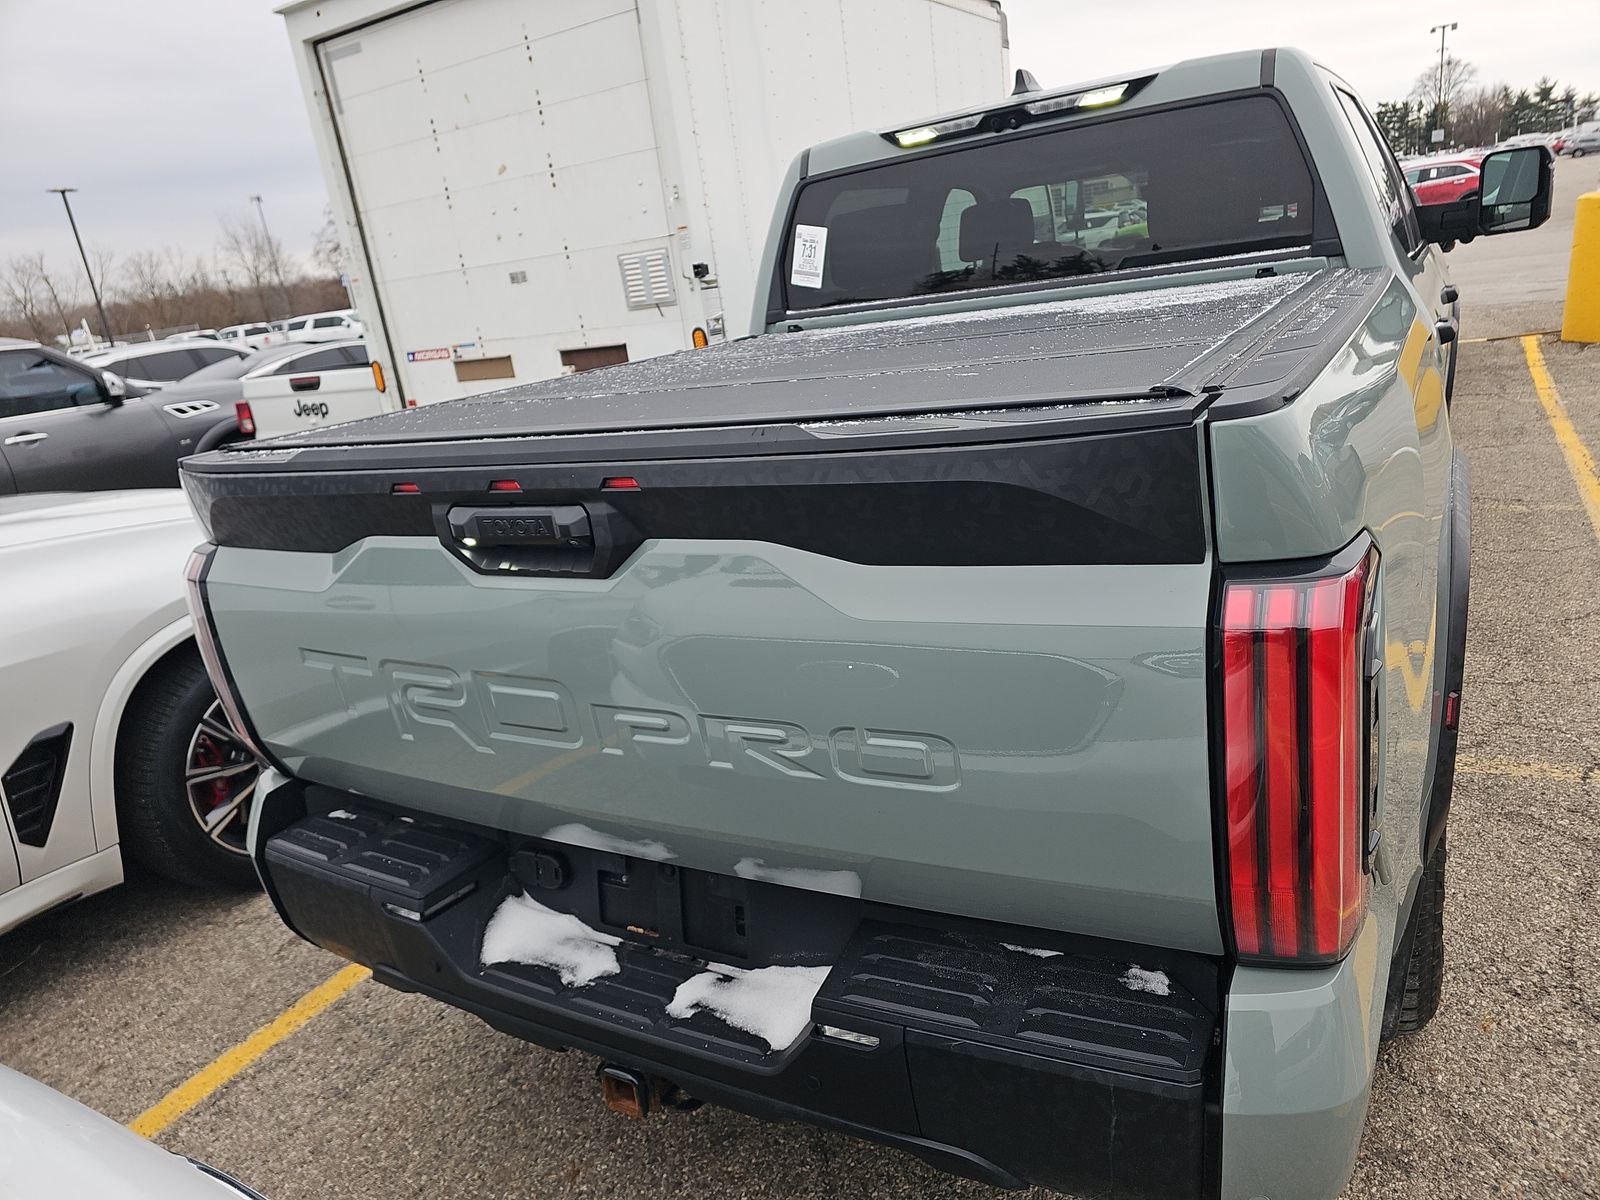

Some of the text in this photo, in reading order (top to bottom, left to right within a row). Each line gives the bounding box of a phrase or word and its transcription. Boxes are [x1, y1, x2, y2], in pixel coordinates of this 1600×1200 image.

[801, 243, 817, 259] 7:31
[293, 399, 329, 419] Jeep
[482, 519, 551, 536] TOYOTA
[297, 646, 962, 793] TRD PRO
